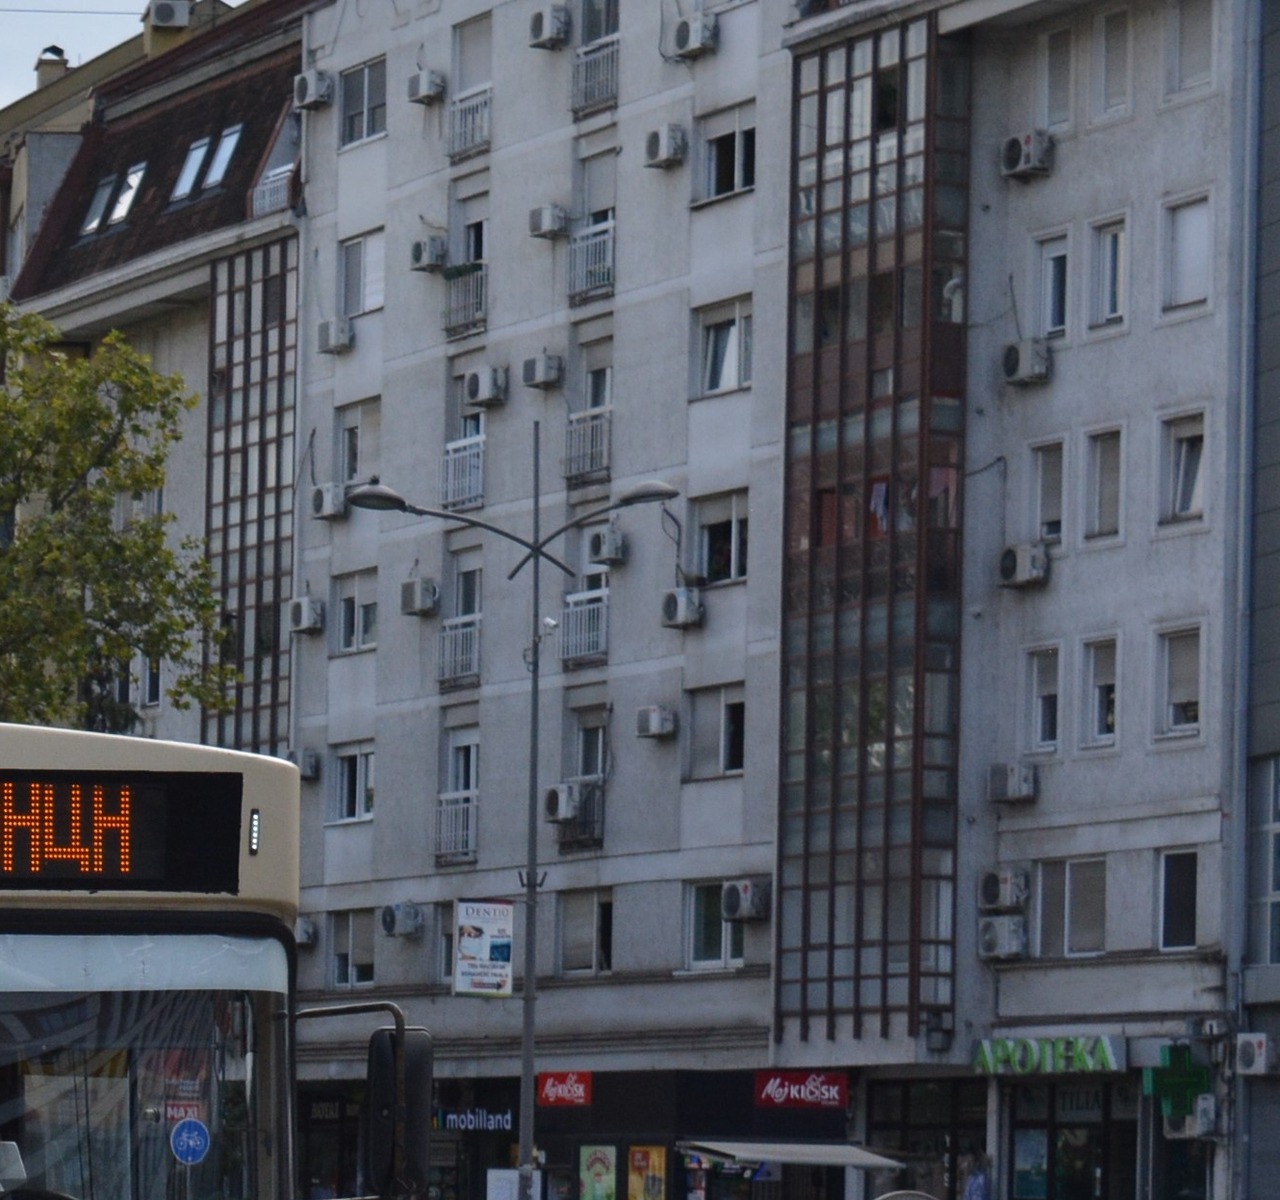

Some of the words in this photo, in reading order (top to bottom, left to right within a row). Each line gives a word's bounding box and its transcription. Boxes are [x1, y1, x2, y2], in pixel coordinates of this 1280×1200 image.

[974, 1035, 1118, 1074] APOTEKA
[166, 1105, 198, 1119] MAXI
[446, 1109, 512, 1131] mobilland
